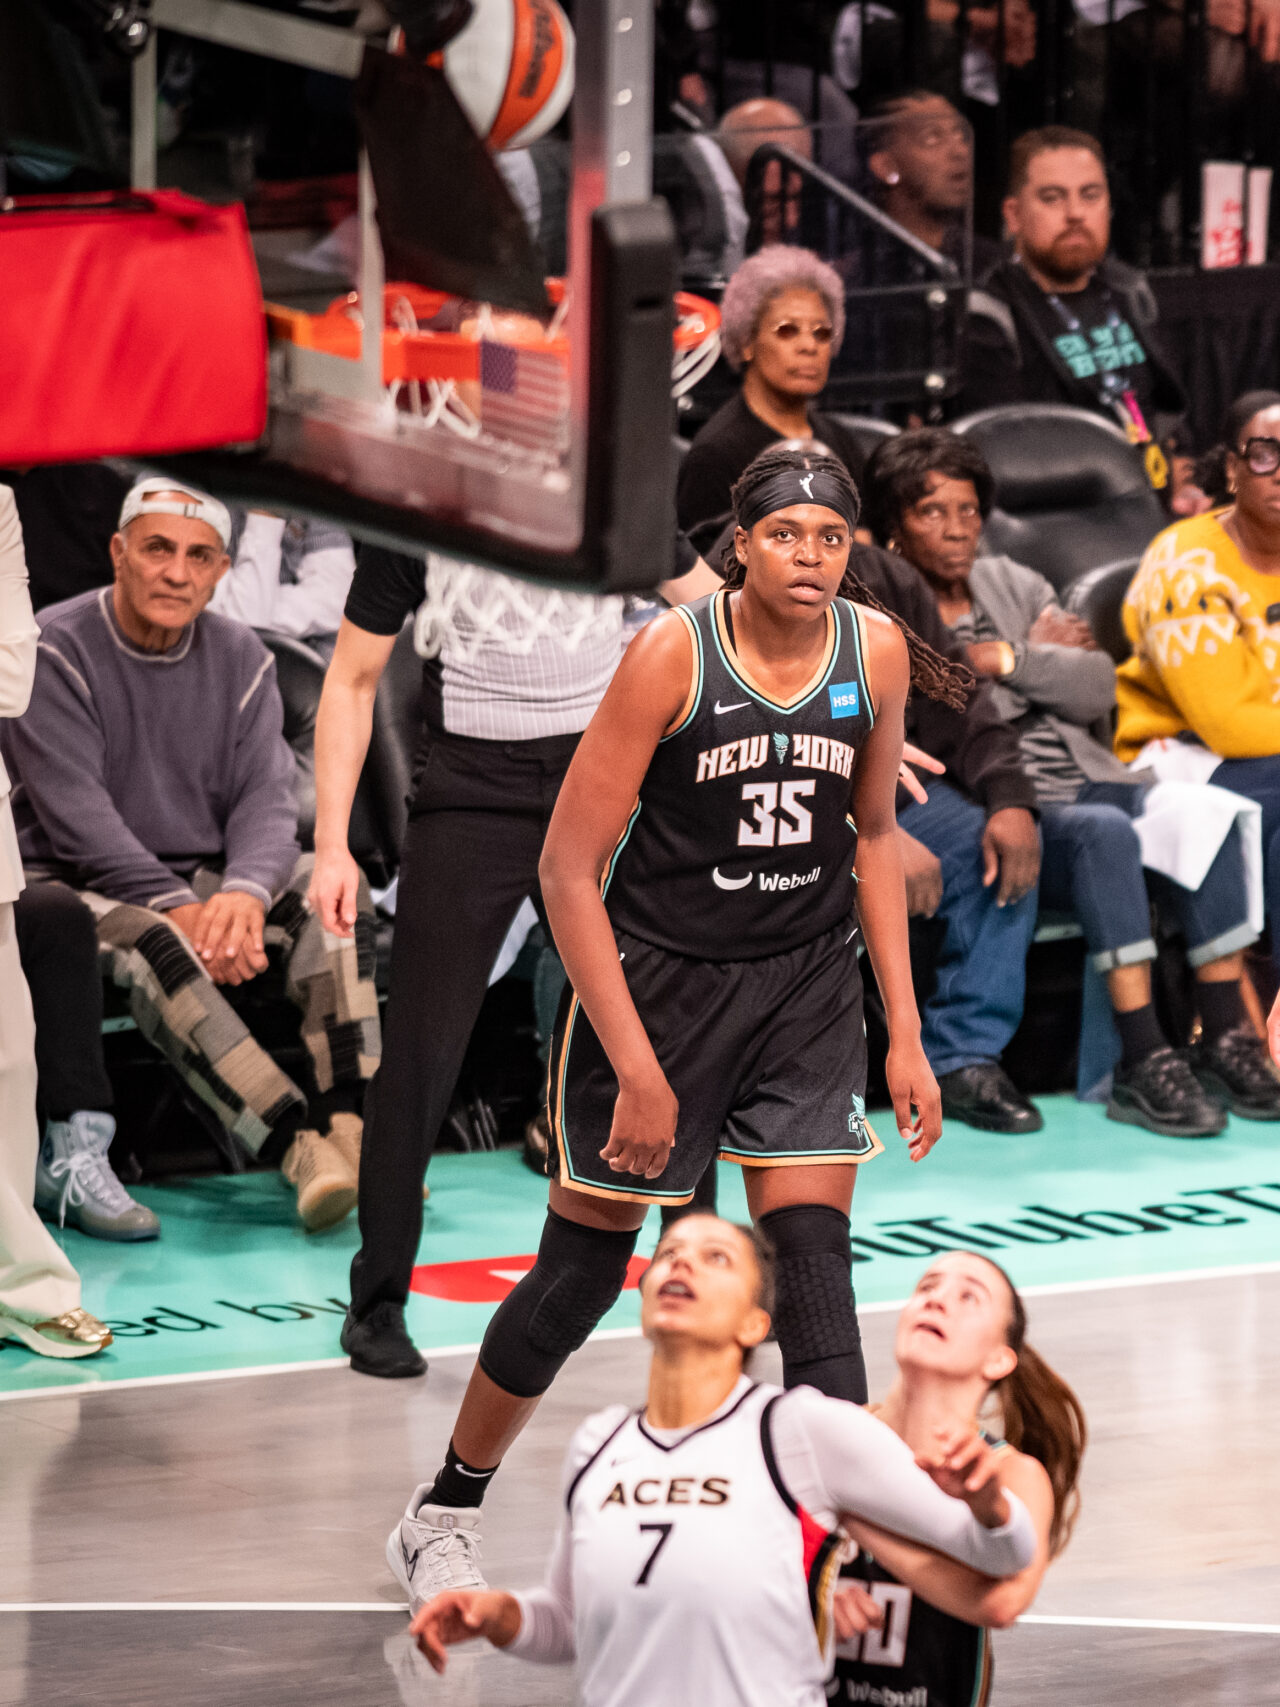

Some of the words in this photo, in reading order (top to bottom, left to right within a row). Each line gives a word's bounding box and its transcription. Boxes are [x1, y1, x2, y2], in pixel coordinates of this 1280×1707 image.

[833, 694, 856, 707] HSS
[696, 733, 769, 783] NEW
[792, 733, 855, 780] YORK
[737, 779, 816, 847] 35
[759, 866, 821, 891] Webull
[599, 1477, 731, 1512] ACES
[635, 1522, 674, 1587] 7
